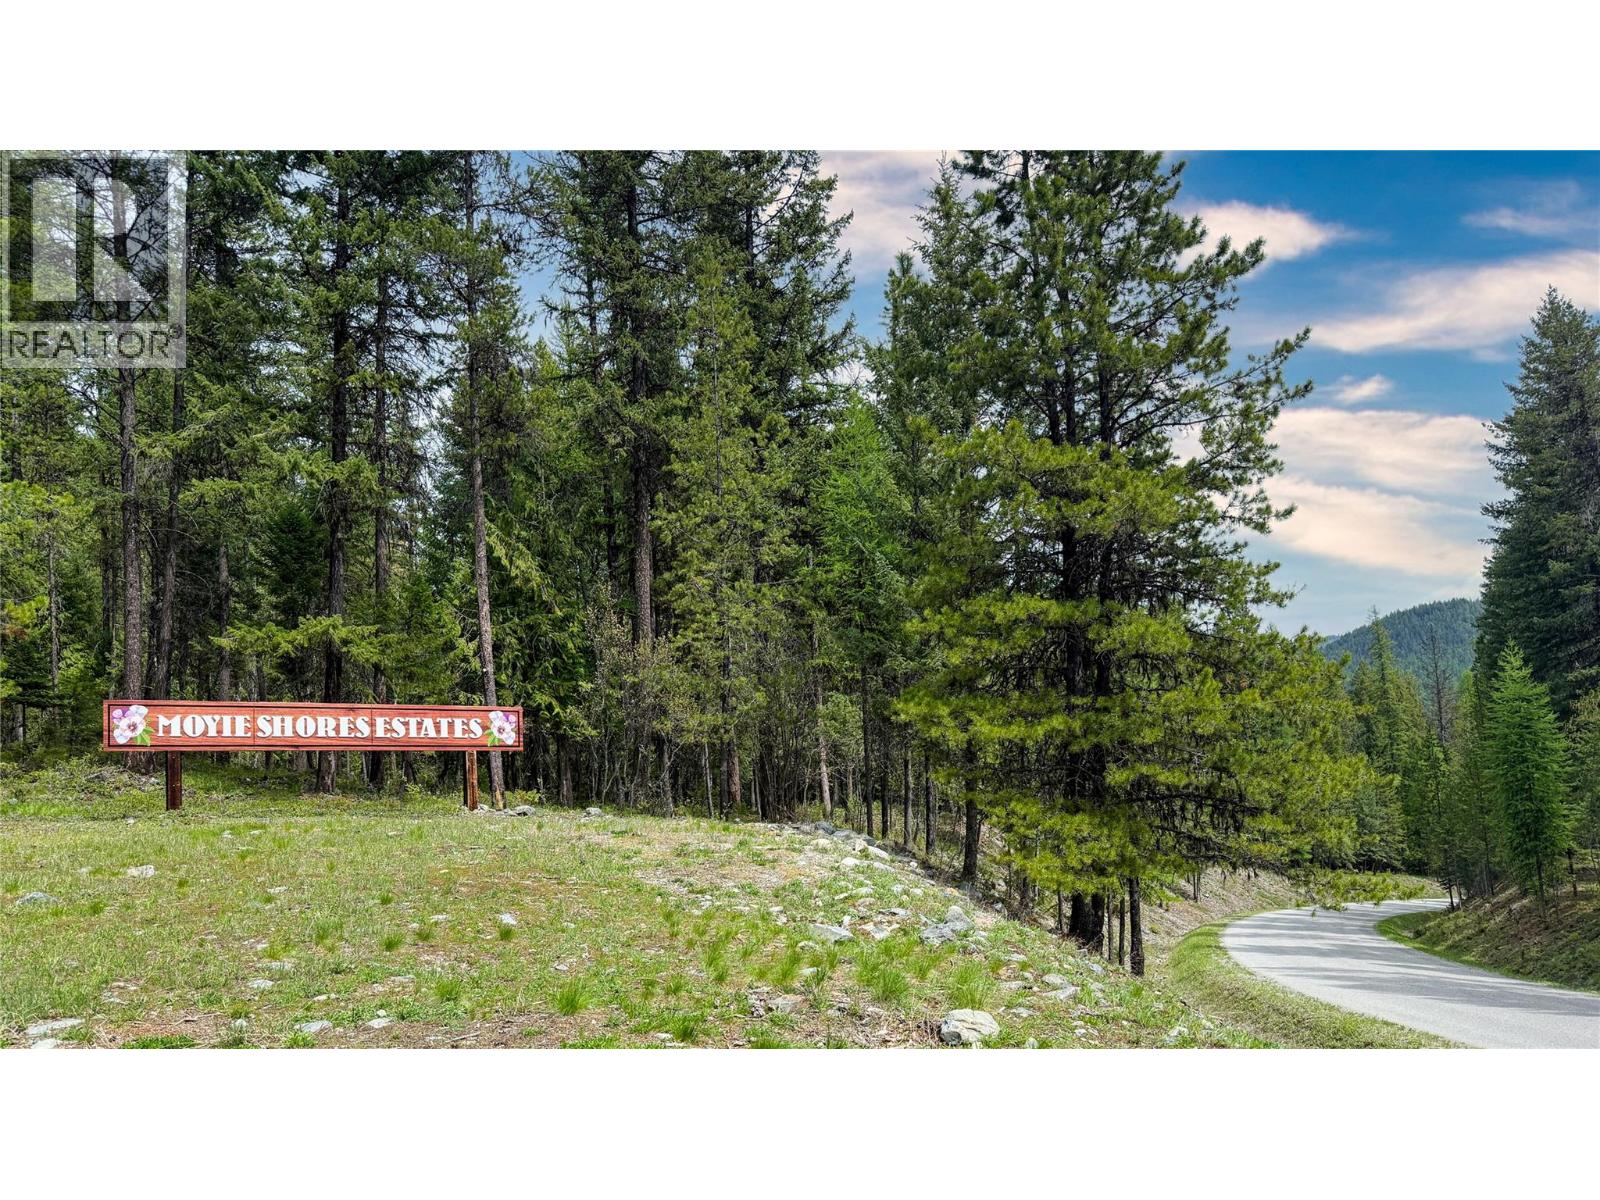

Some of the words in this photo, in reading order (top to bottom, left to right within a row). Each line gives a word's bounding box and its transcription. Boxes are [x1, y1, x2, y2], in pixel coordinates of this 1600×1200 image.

[157, 714, 251, 737] MOYIE
[256, 715, 371, 738] SHORES
[374, 717, 483, 739] ESTATES
